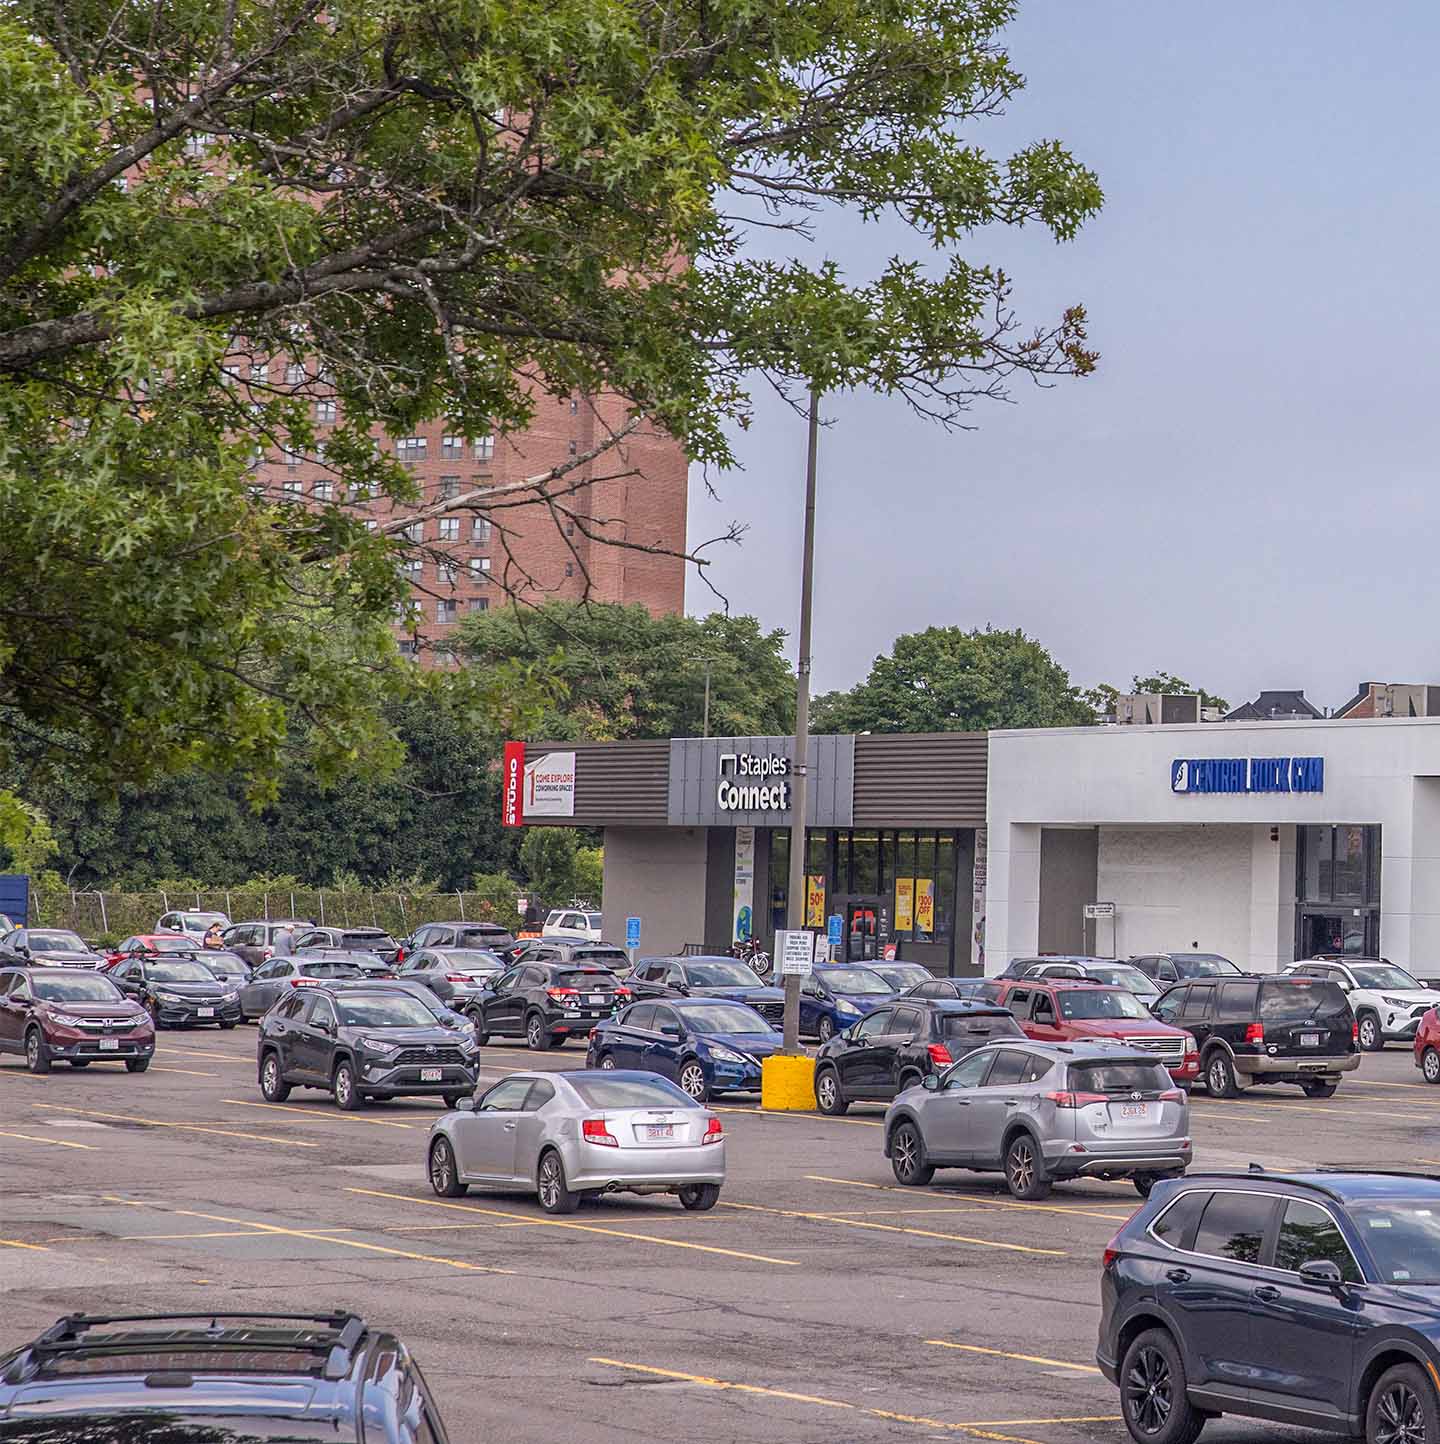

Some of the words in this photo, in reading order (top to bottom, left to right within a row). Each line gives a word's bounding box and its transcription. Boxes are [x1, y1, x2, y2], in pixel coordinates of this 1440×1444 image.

[536, 774, 550, 783] COME
[551, 774, 574, 783] EXPLORE
[740, 753, 787, 781] Staples
[1190, 759, 1249, 792] CENTRAL
[1250, 758, 1290, 792] ROCK
[1291, 757, 1323, 792] GYM
[509, 758, 517, 825] STUDIO
[718, 780, 787, 810] Connect
[919, 906, 931, 914] OFF
